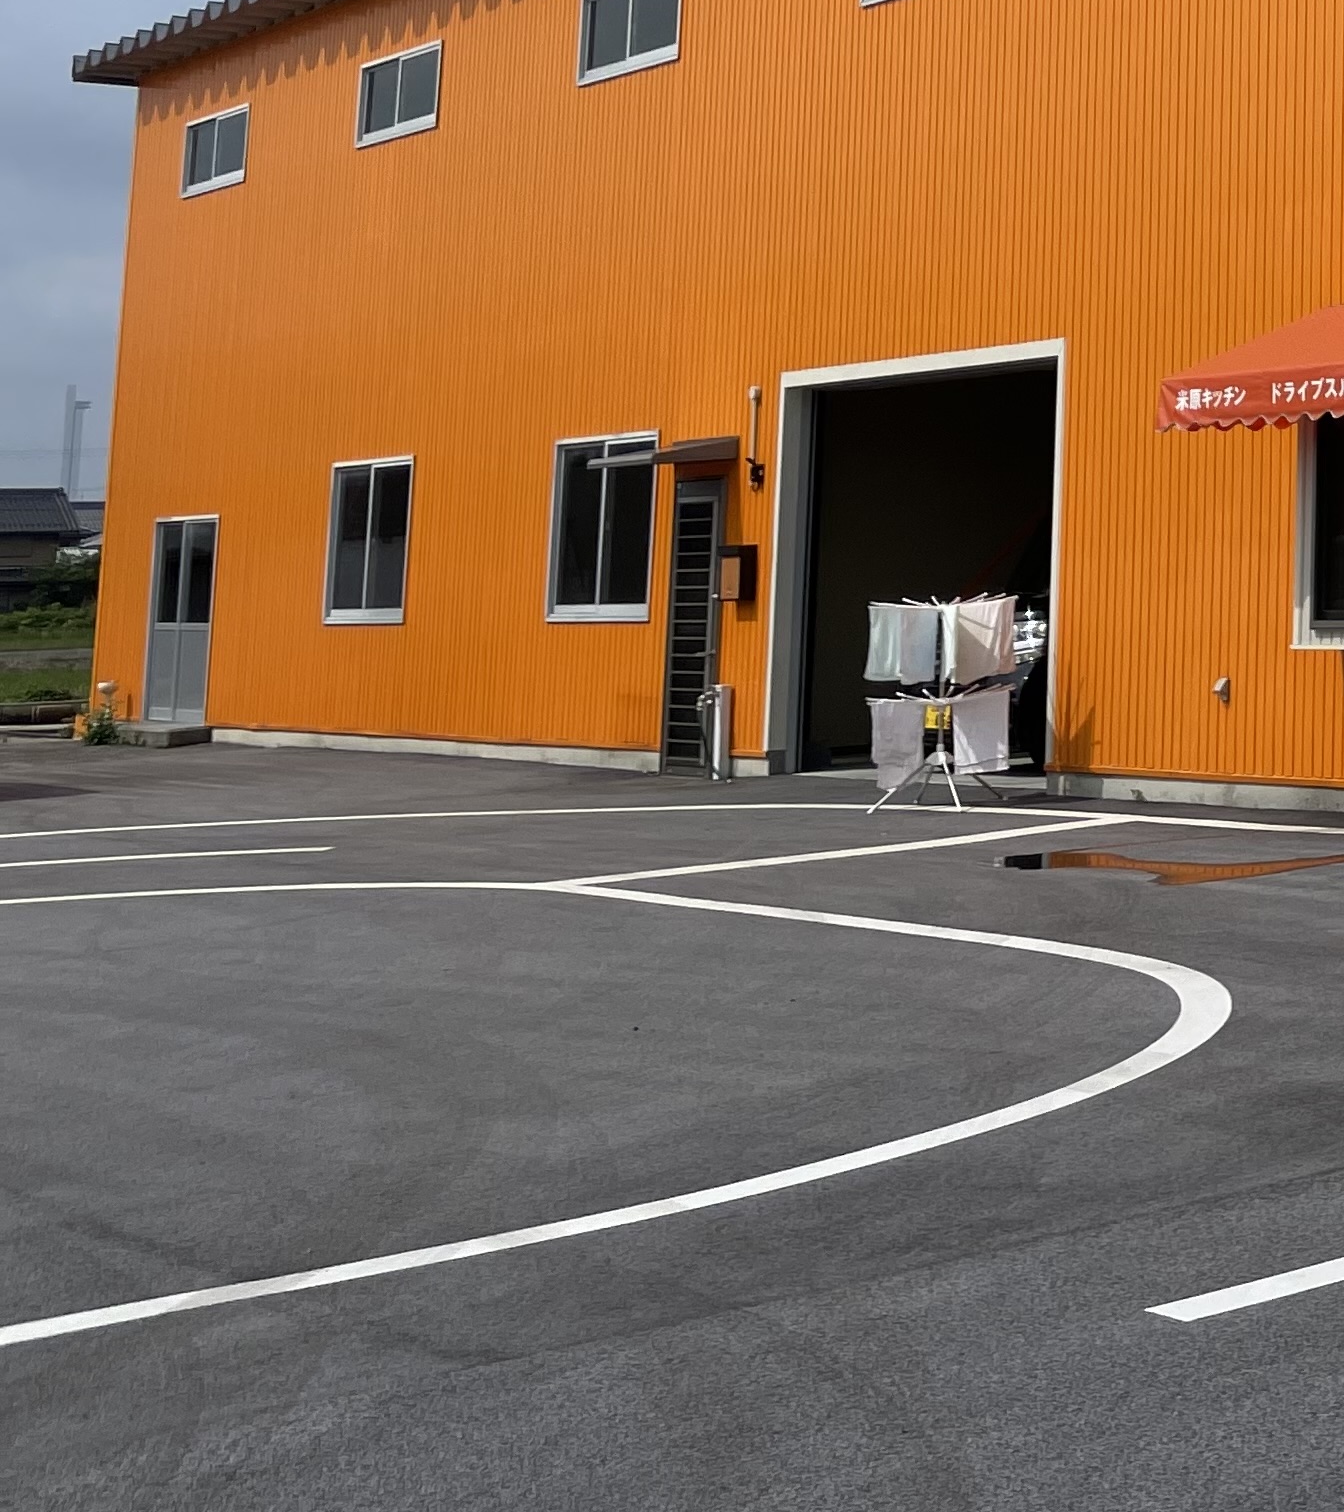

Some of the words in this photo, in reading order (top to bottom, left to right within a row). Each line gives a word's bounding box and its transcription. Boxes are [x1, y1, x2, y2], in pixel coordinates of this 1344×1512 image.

[1175, 386, 1246, 411] 米原キッチン
